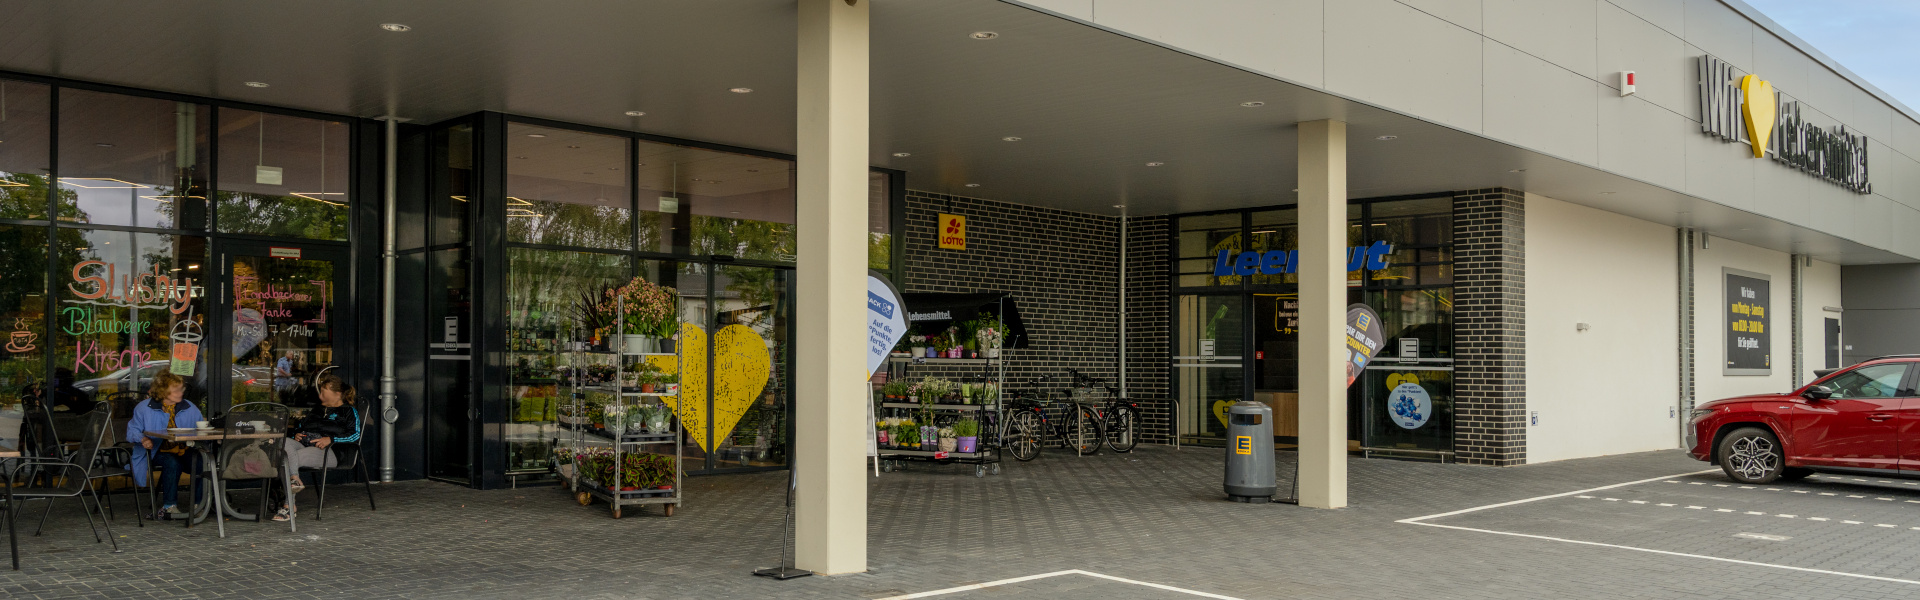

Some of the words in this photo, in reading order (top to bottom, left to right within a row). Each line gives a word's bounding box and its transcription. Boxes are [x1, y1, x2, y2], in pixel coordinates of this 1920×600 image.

[1698, 55, 1744, 143] Wir
[942, 236, 964, 246] LOTTO
[867, 297, 881, 308] ACK
[908, 310, 952, 321] Lebensmittel.
[269, 324, 277, 336] 7
[872, 319, 883, 328] Auf
[884, 325, 893, 334] die
[870, 335, 887, 350] fertig,
[1355, 330, 1365, 343] DIR
[1365, 337, 1377, 350] DEN
[75, 338, 152, 373] Kirsche
[872, 345, 883, 356] los!
